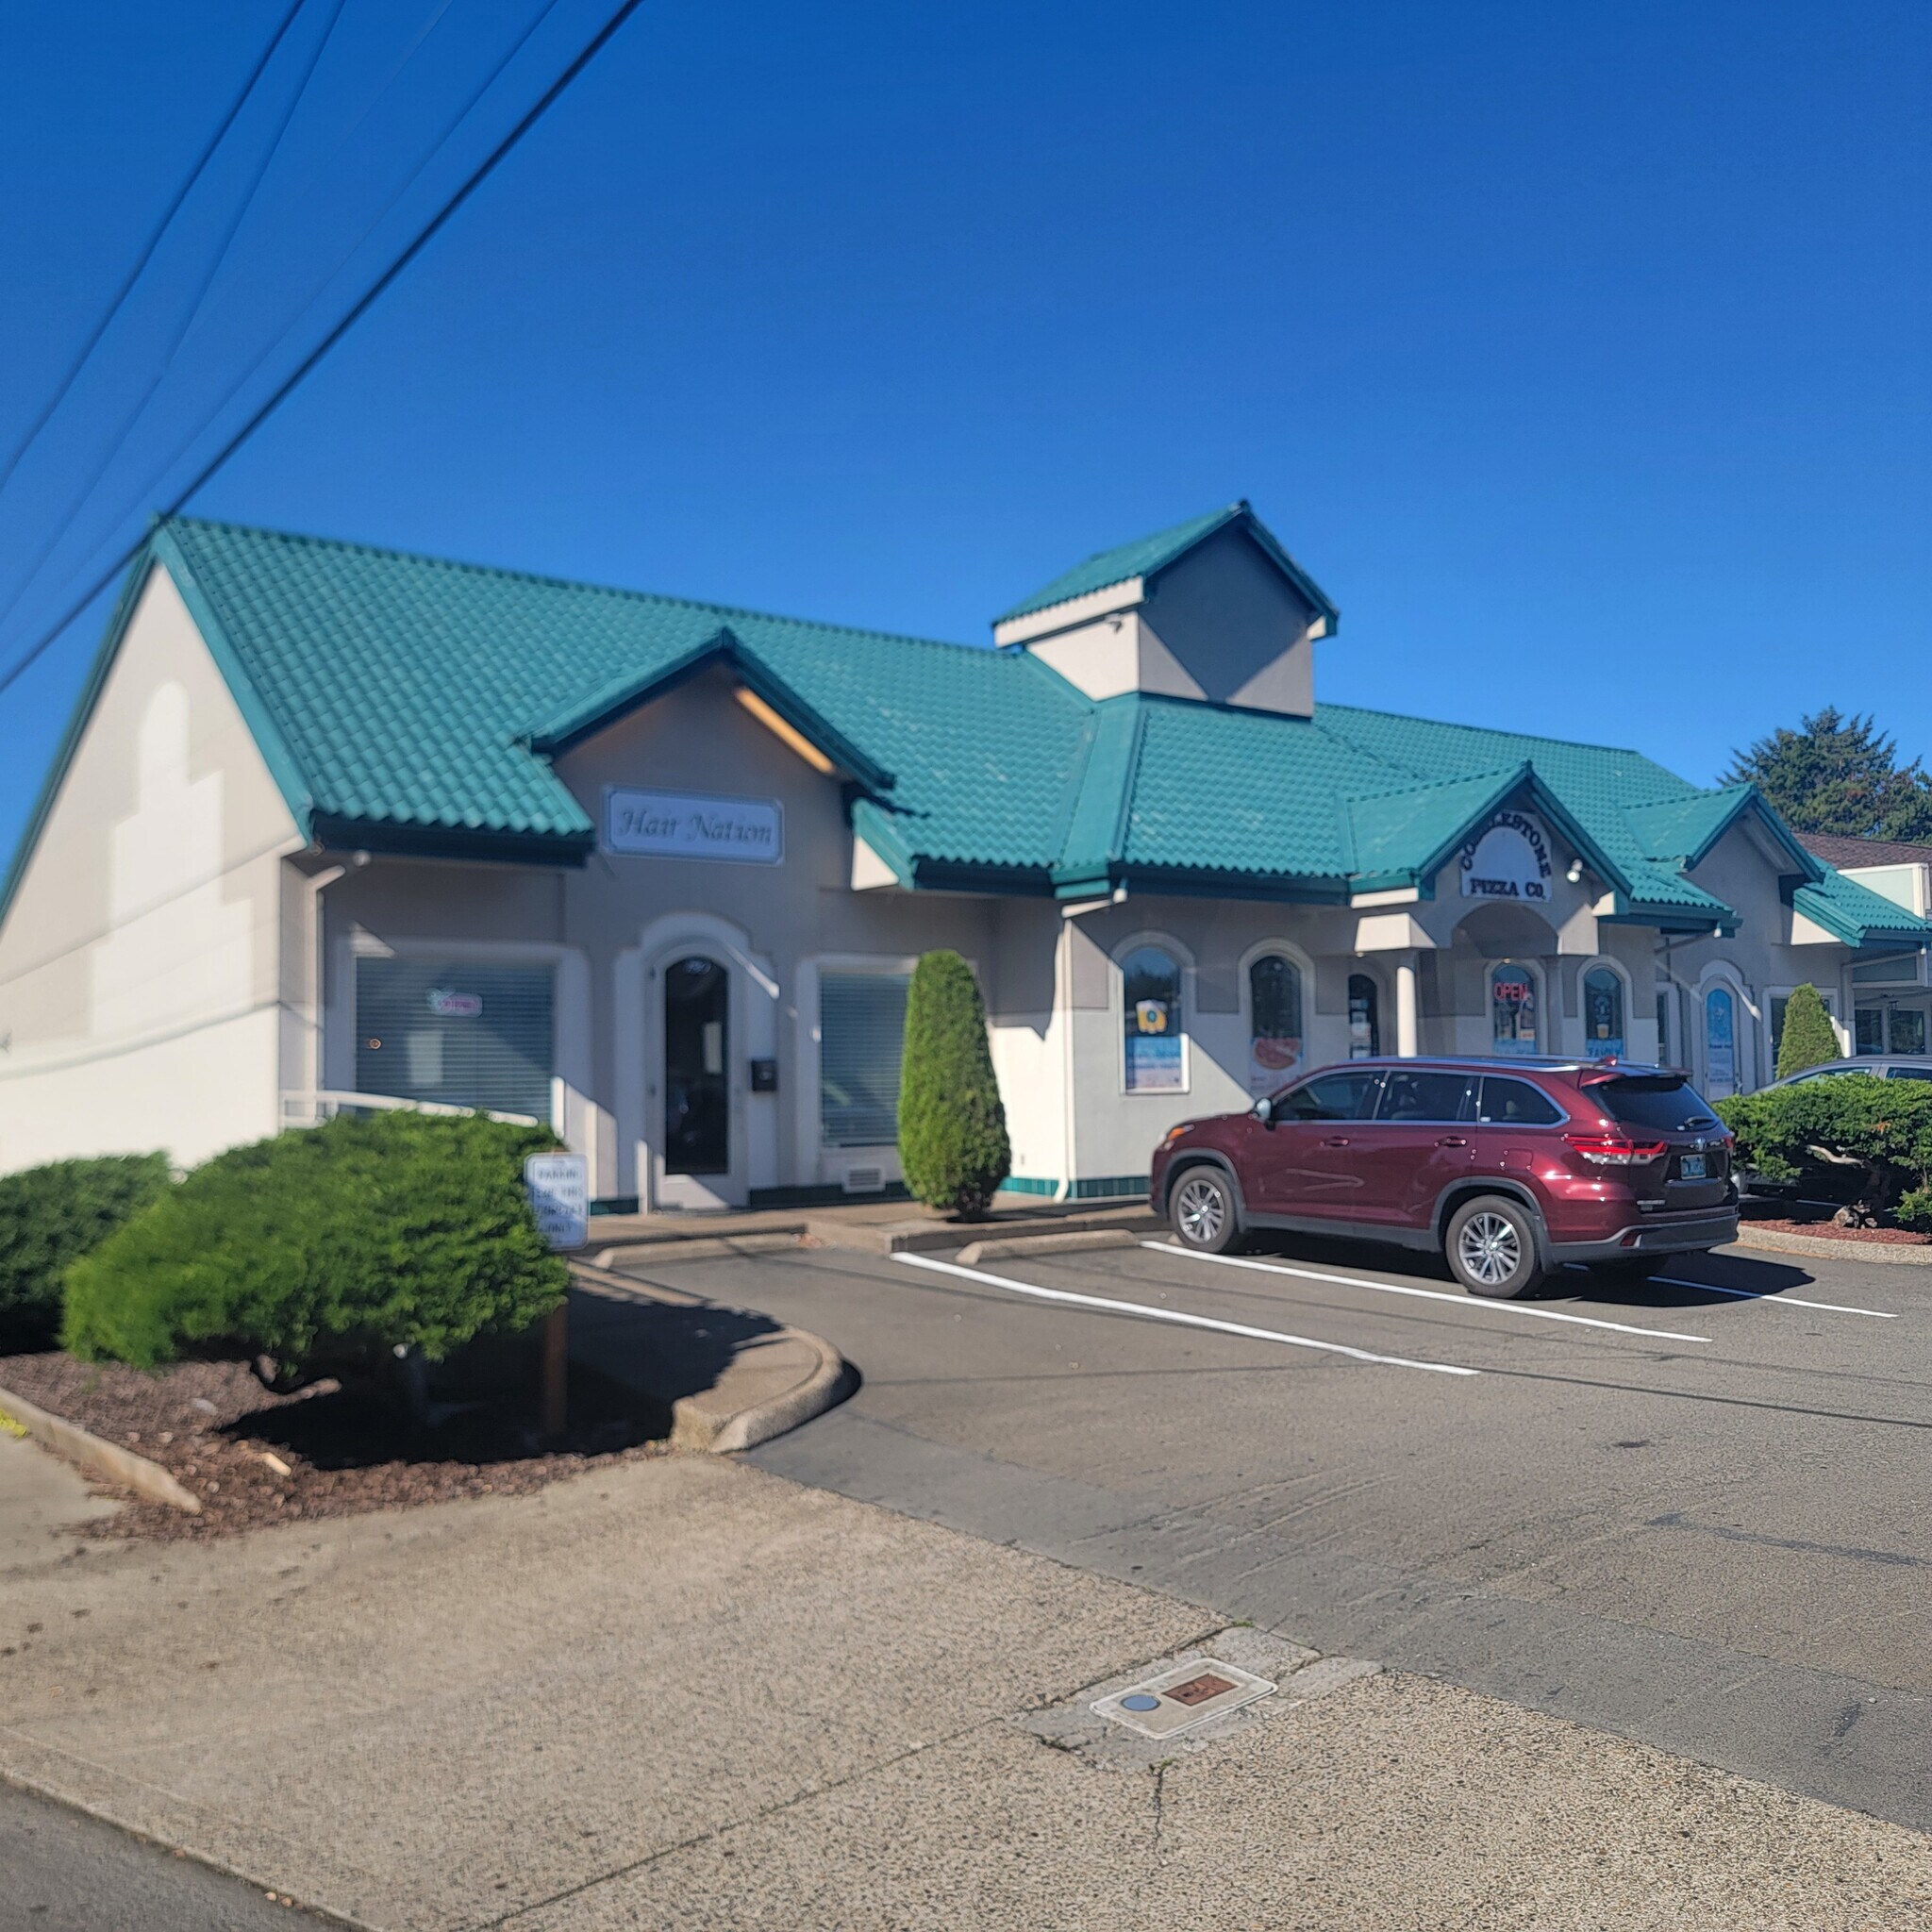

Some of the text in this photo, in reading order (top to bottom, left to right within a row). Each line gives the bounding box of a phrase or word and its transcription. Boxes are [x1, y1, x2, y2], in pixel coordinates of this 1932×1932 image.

[619, 809, 773, 846] Hair Nation
[1459, 812, 1552, 878] COLESTONE
[1470, 878, 1520, 896] PIZZA
[1493, 982, 1527, 1002] OPEN
